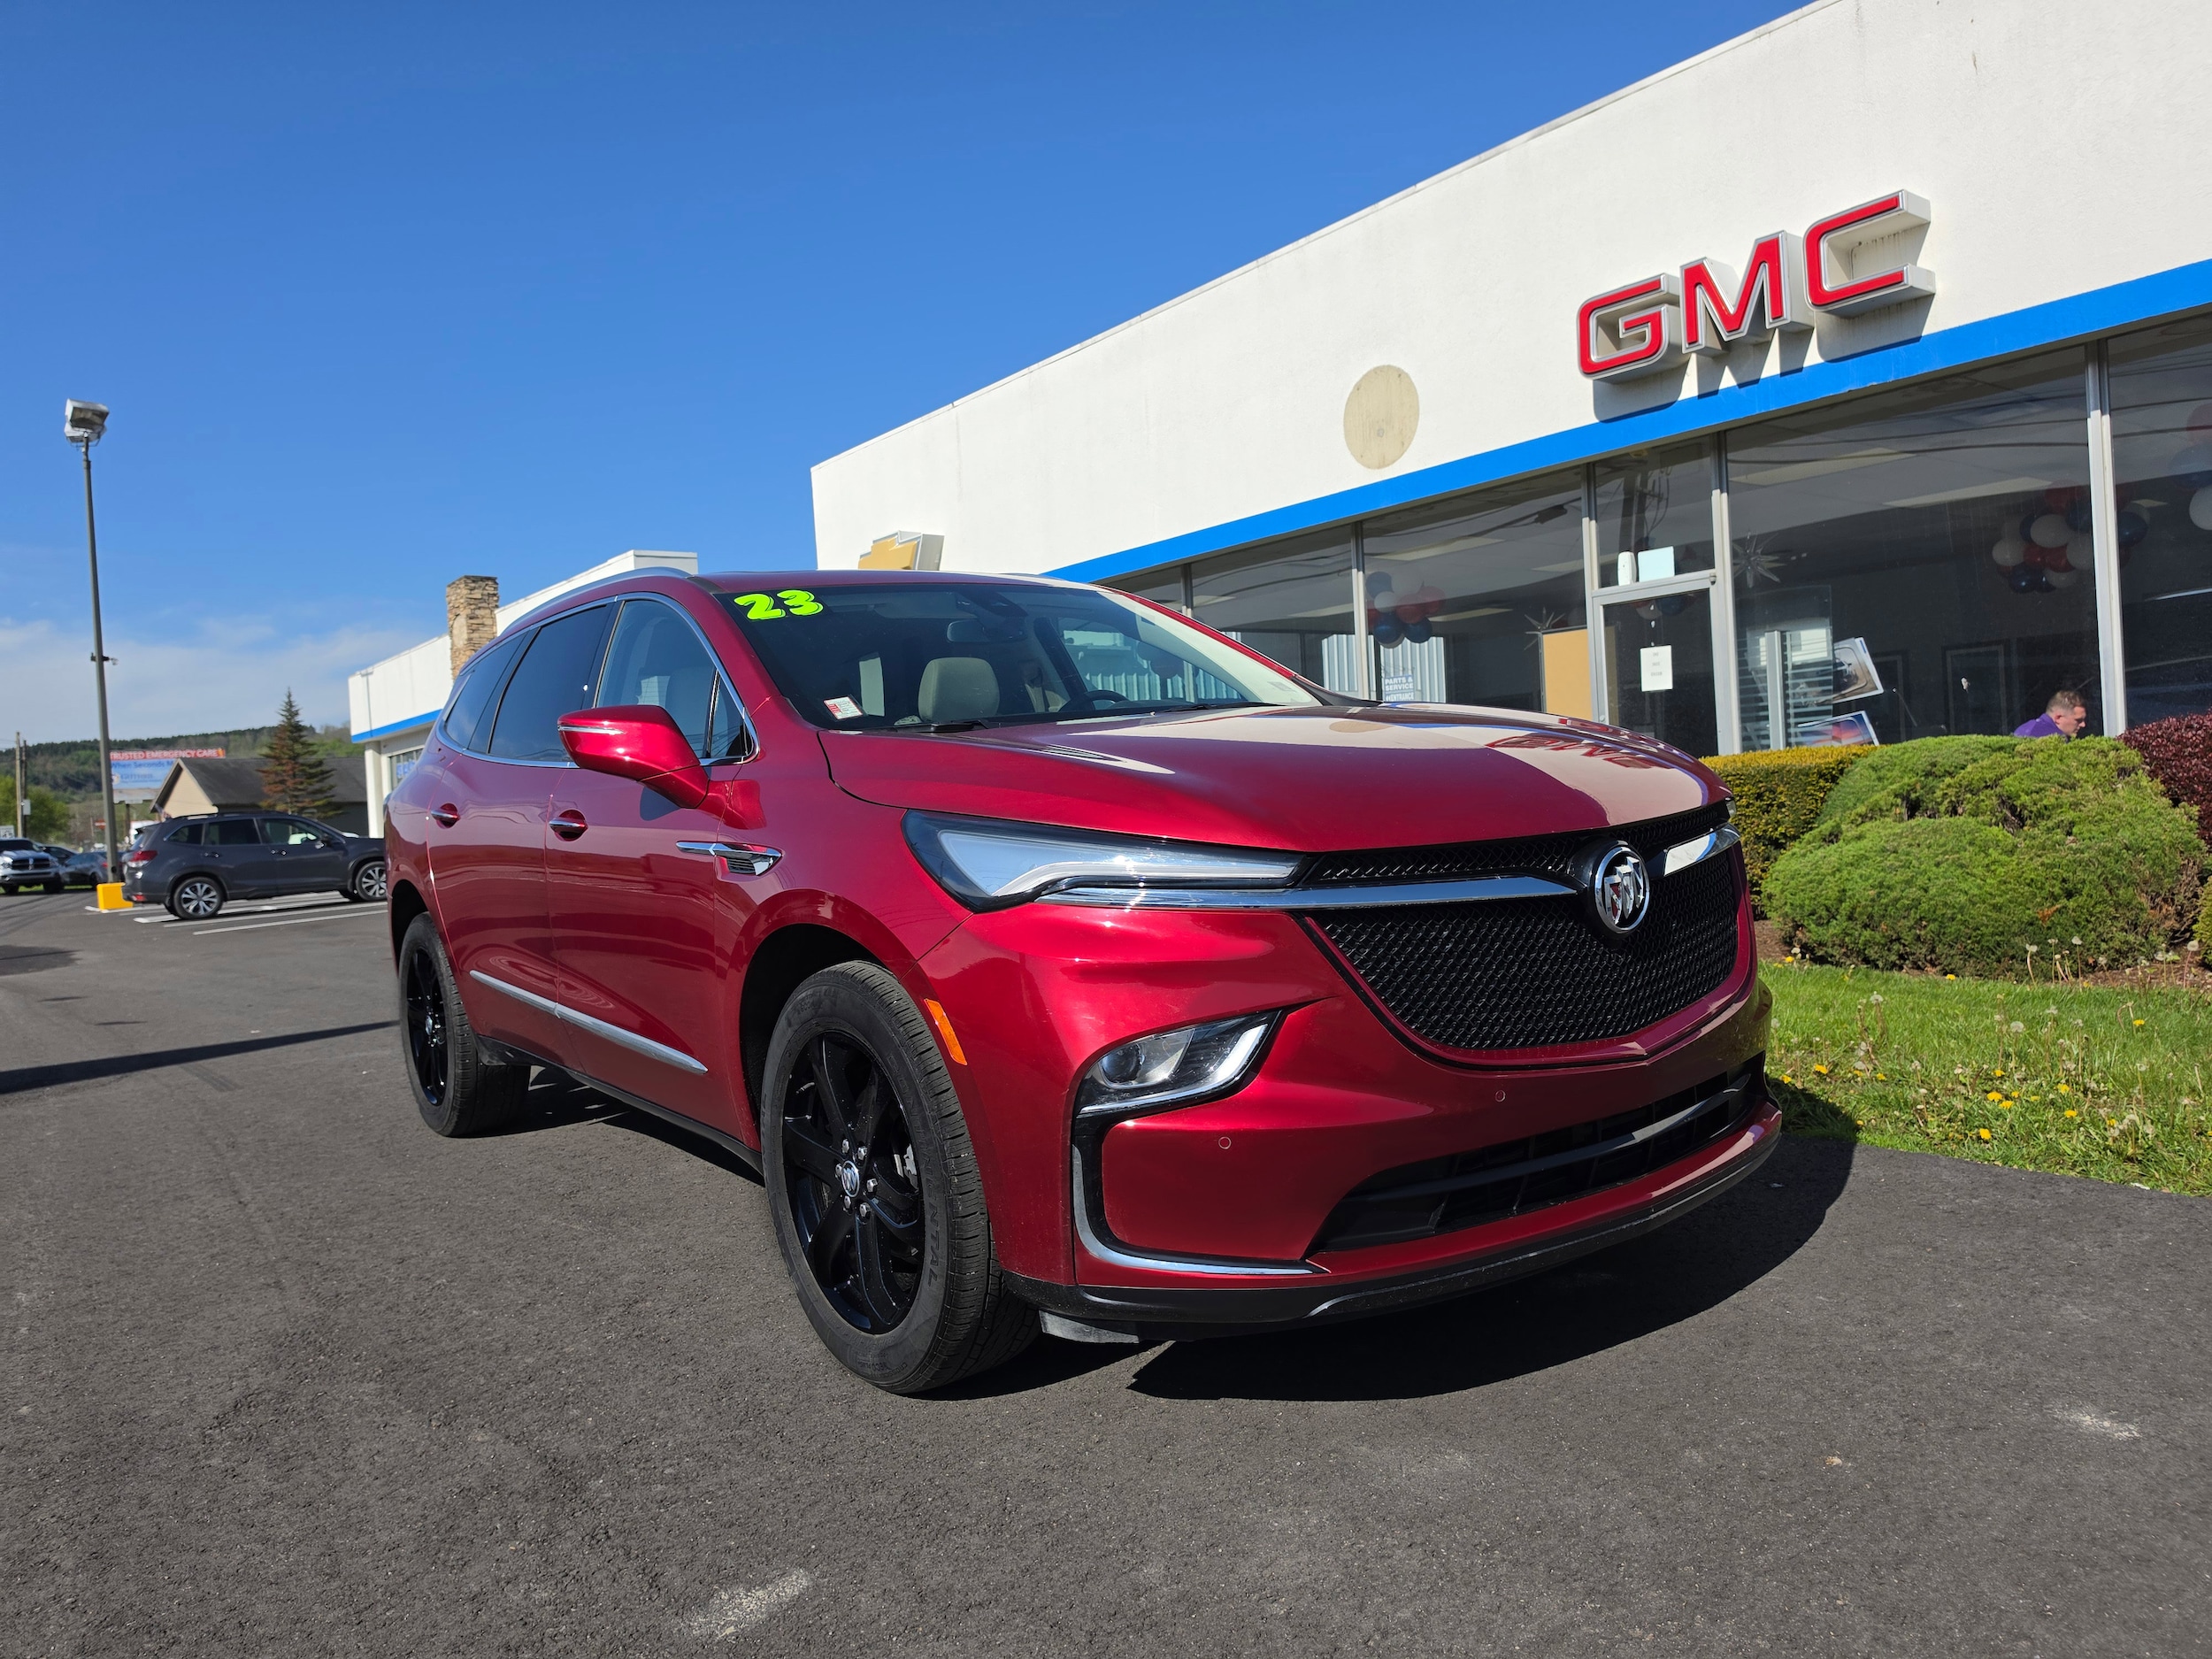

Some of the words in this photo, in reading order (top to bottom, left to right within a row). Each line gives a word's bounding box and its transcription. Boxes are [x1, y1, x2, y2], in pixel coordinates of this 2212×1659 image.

[1577, 188, 1935, 382] GMC
[734, 589, 824, 620] 23
[110, 751, 145, 760] TRUSTED
[147, 749, 196, 759] EMERGENCY
[196, 749, 219, 757] CARE
